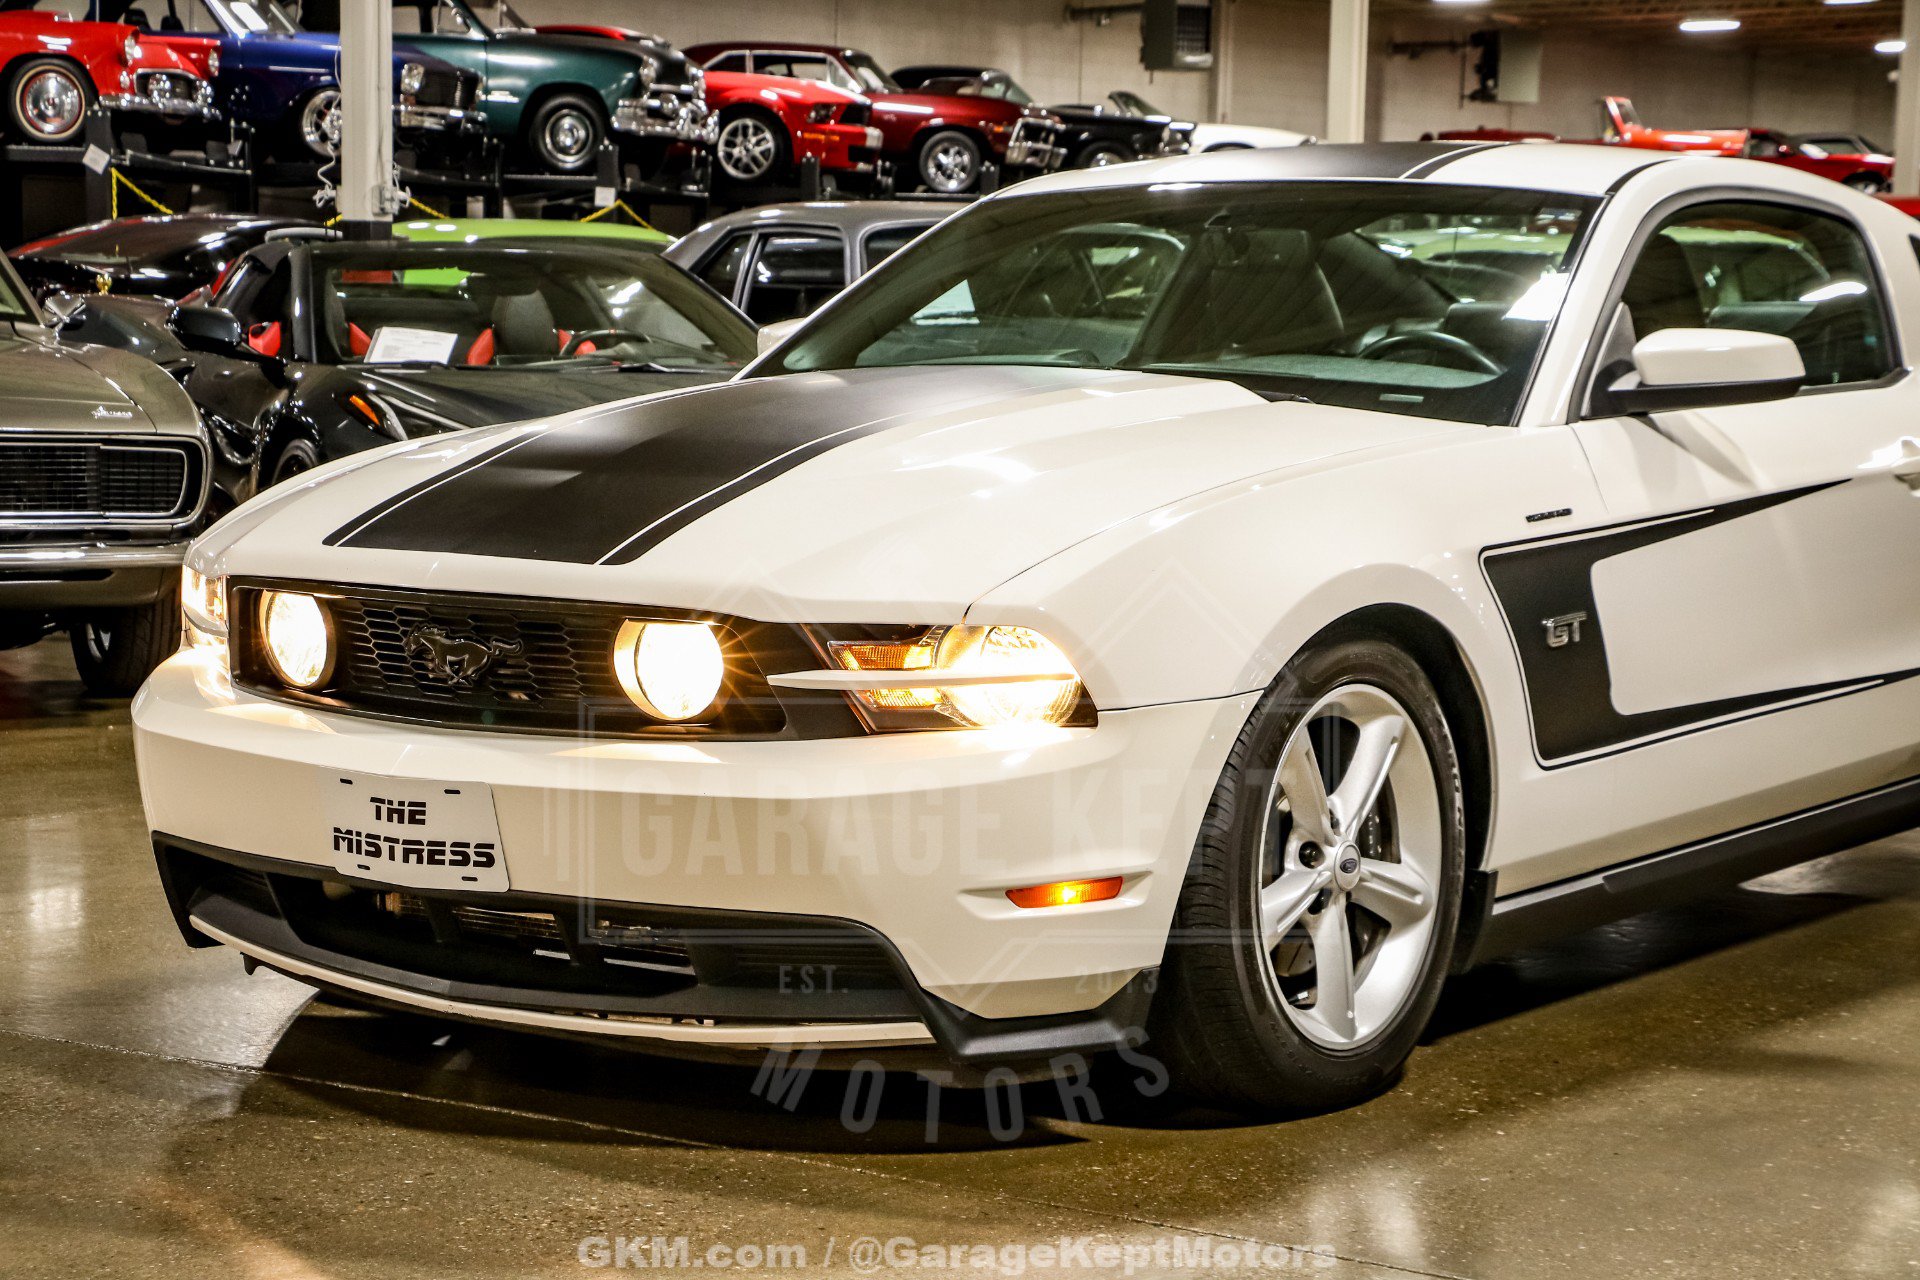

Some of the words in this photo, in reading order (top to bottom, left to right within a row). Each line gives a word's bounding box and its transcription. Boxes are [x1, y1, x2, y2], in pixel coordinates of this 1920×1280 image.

[1542, 611, 1587, 648] GT
[370, 796, 427, 826] THE
[333, 826, 496, 869] MISTRESS
